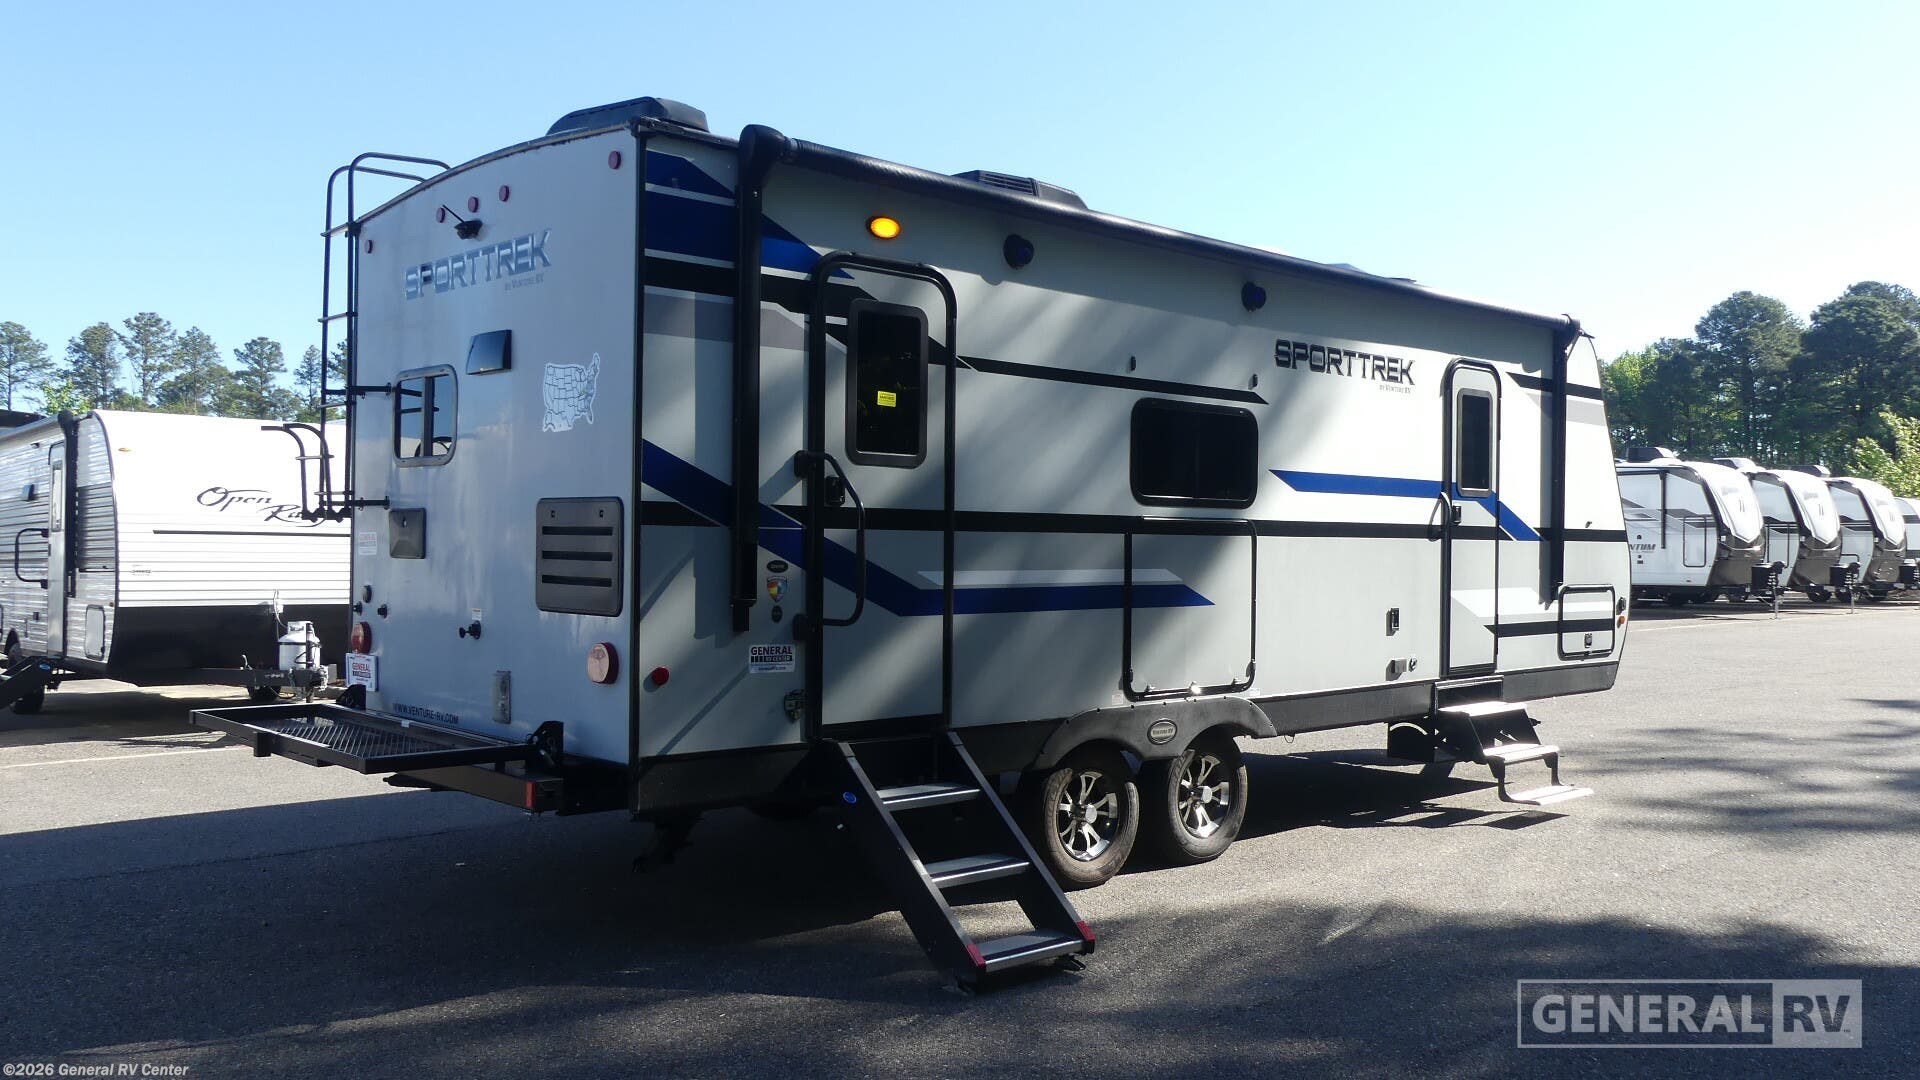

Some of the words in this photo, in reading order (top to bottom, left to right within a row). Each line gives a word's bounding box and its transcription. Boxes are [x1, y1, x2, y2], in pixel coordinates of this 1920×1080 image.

[405, 228, 551, 300] SPORTTREK
[1275, 338, 1416, 386] SPORTTREK
[197, 486, 272, 512] Open
[751, 646, 792, 655] GENERAL
